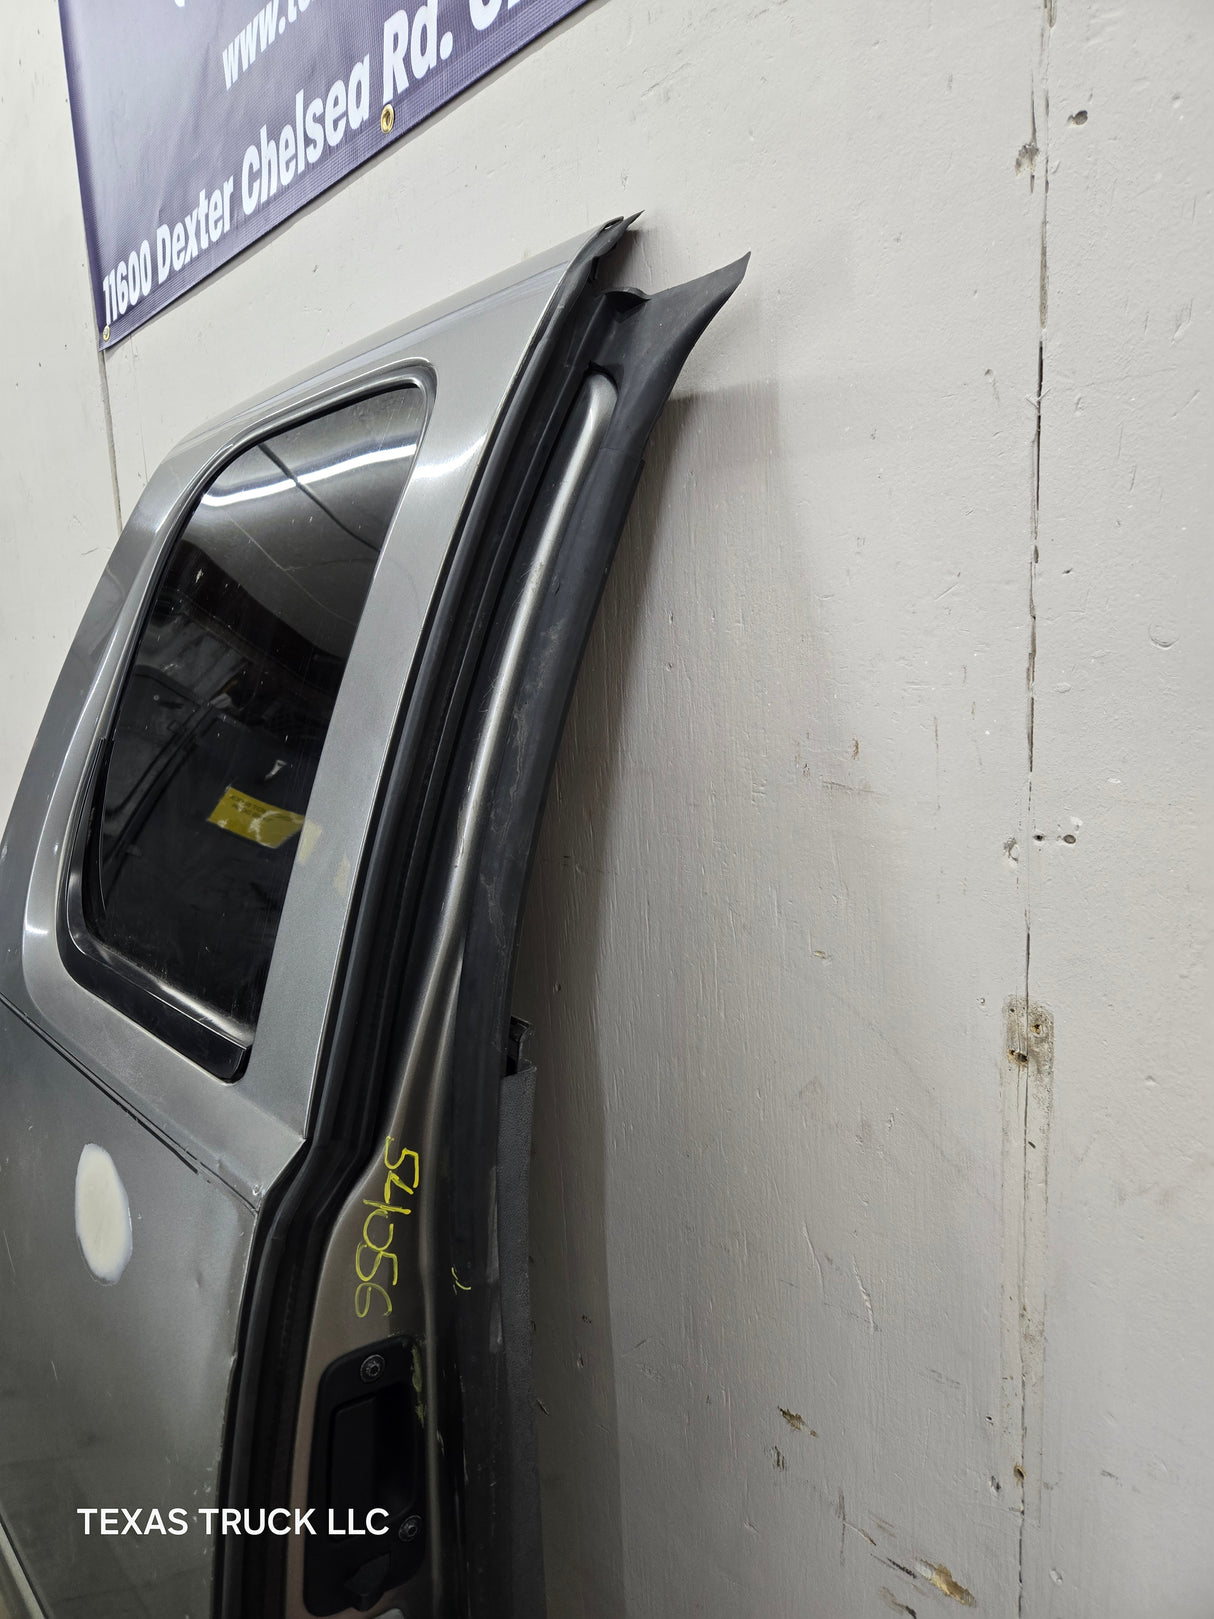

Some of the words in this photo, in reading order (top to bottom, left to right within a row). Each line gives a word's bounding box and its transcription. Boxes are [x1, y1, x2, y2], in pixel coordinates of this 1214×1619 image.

[222, 0, 311, 91] www.t
[103, 239, 152, 325] 11600
[156, 174, 234, 285] Dexter
[241, 53, 370, 215] Chelsea
[383, 0, 454, 106] Rd.
